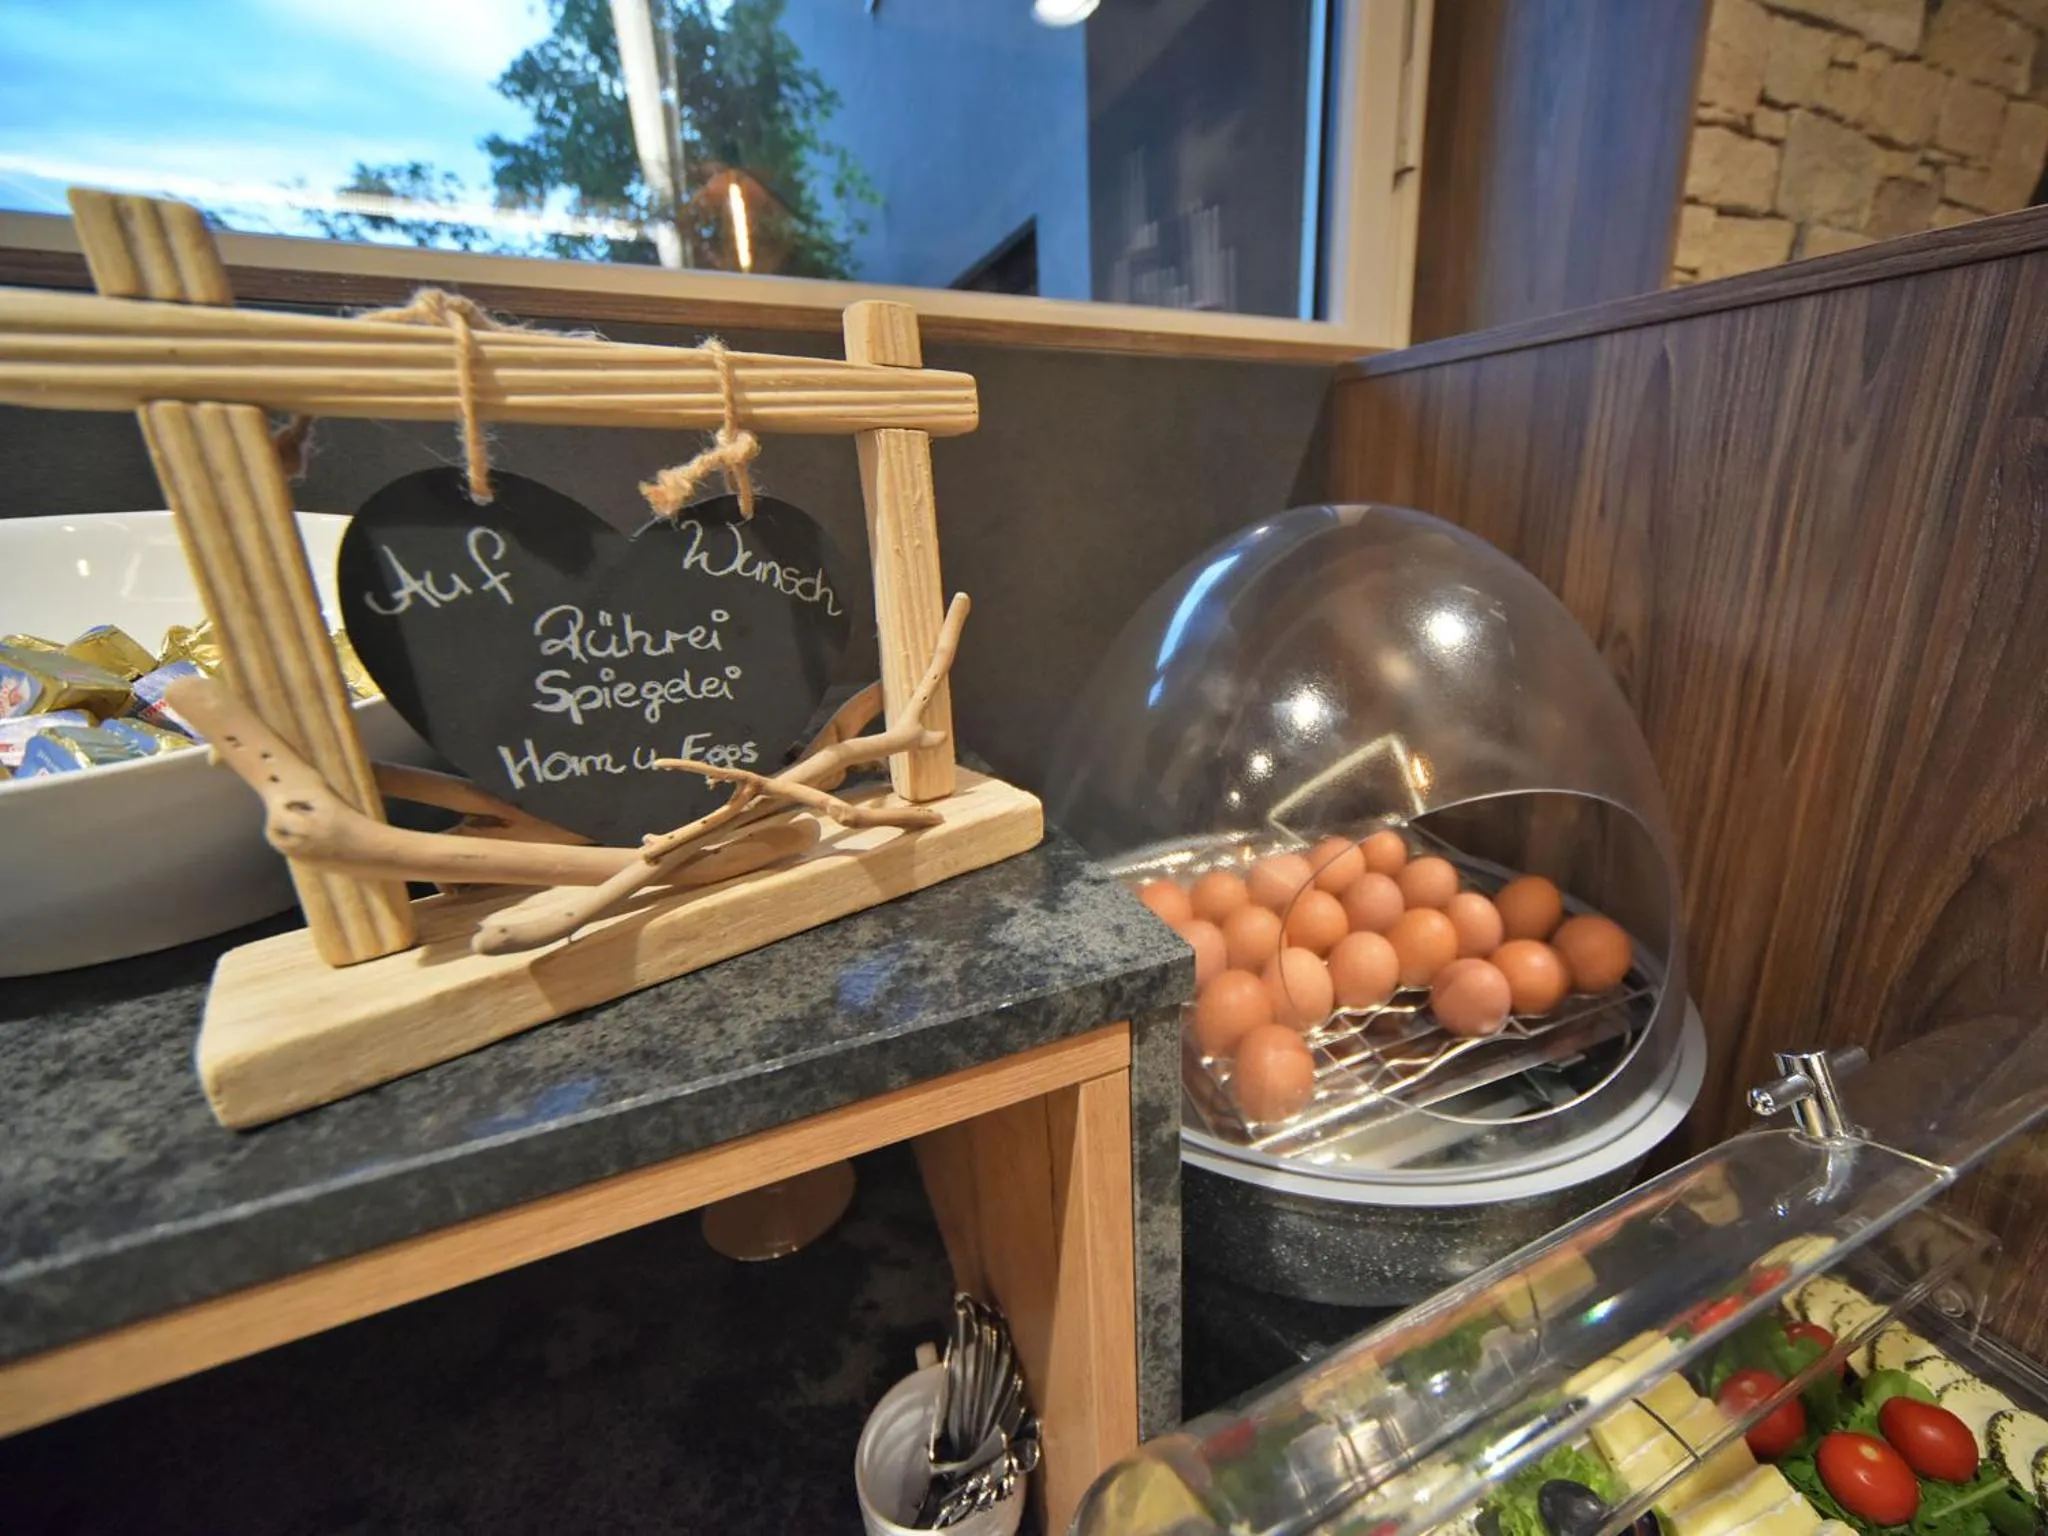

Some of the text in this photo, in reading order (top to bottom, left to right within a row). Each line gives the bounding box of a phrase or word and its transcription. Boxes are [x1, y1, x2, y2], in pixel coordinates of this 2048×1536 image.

[365, 520, 843, 616] Auf Wunsch
[534, 604, 730, 664] Rührei
[532, 665, 742, 725] Spiegelei
